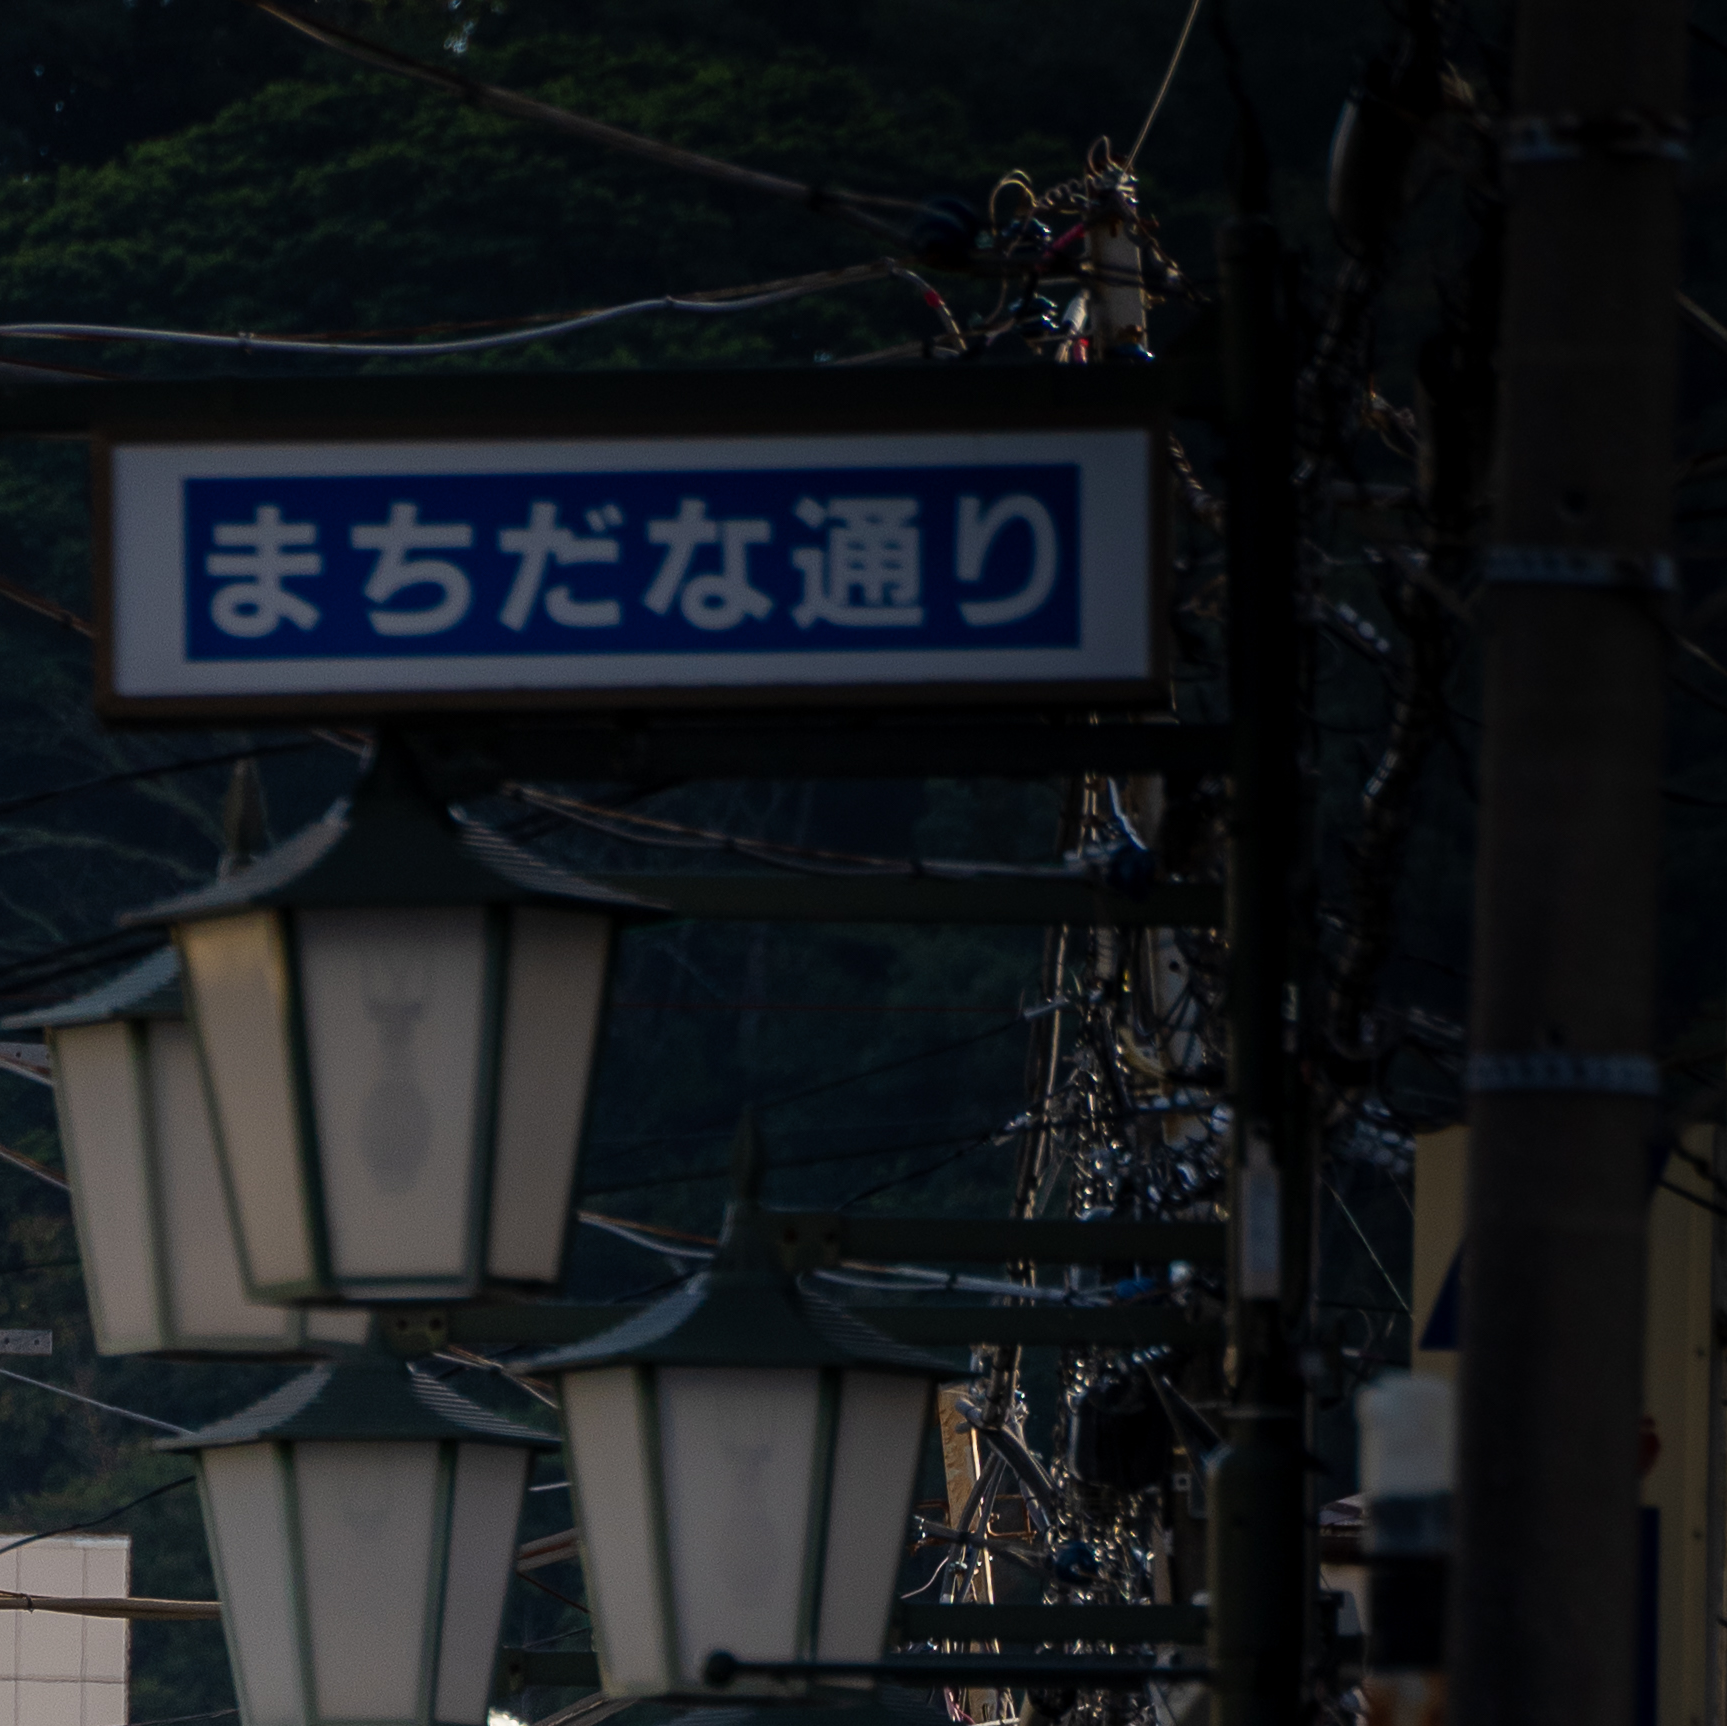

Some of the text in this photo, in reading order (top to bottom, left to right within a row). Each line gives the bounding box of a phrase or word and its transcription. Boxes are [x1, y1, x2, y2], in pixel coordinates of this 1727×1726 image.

[205, 494, 1059, 638] まちだな通り
